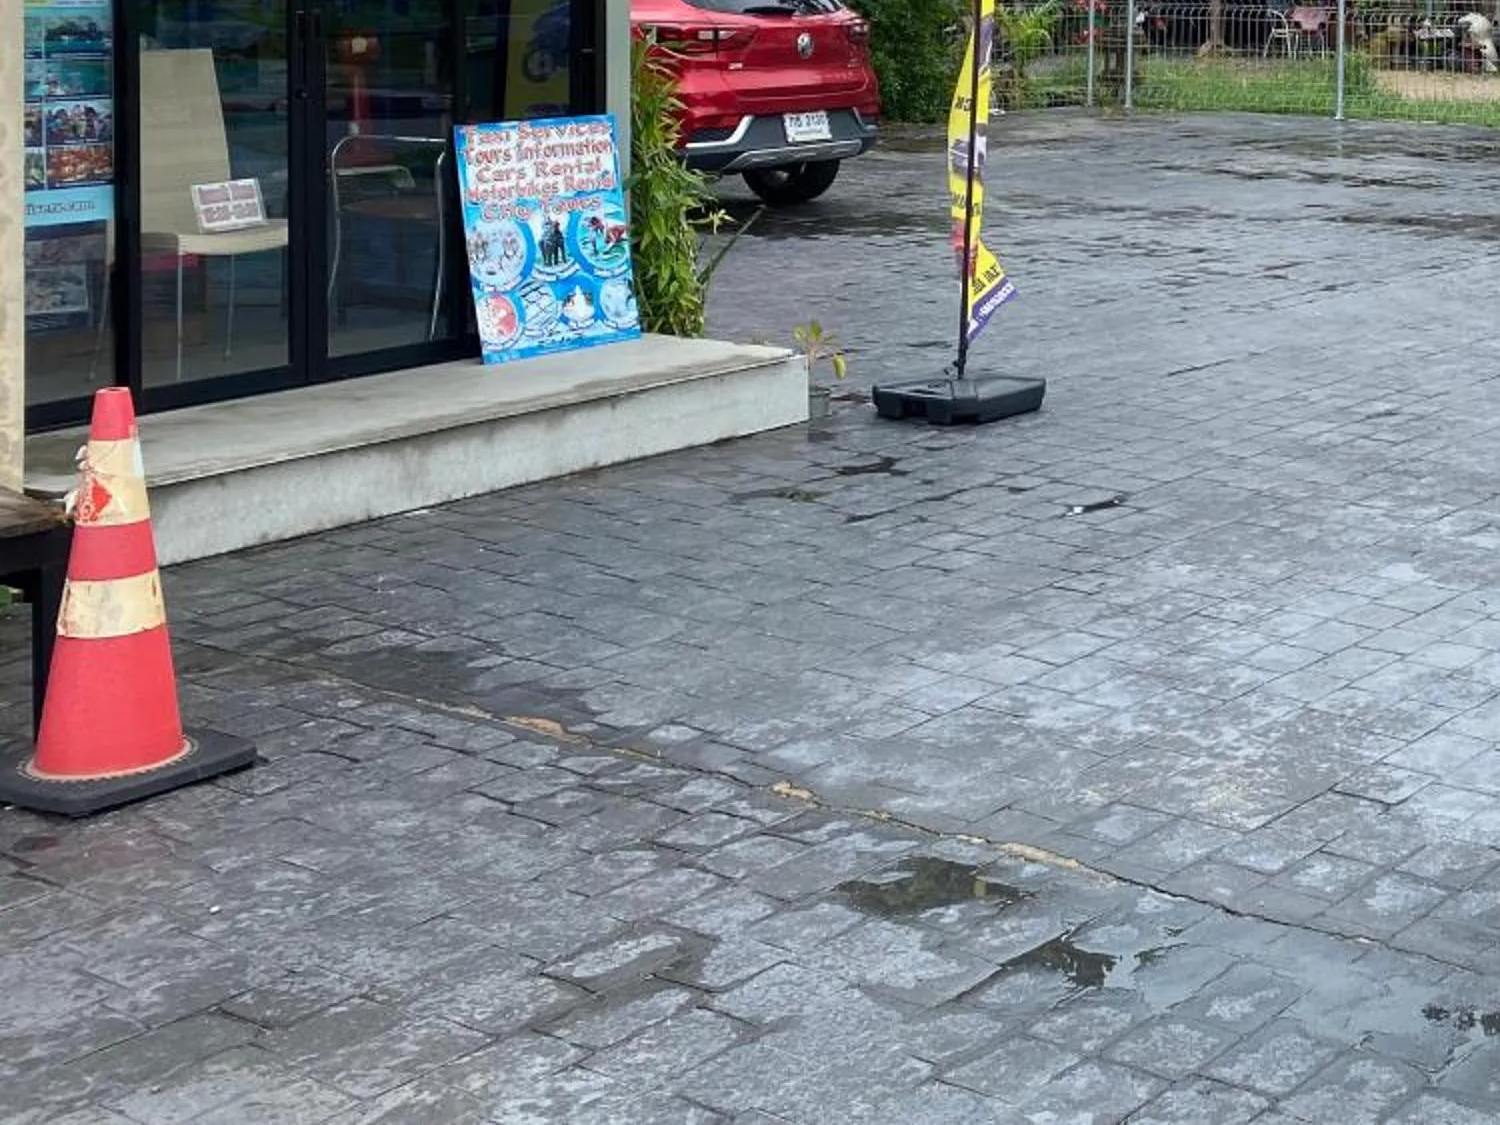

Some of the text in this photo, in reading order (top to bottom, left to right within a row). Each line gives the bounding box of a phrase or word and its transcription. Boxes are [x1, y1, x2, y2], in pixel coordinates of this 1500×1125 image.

[518, 122, 612, 140] Services
[465, 137, 612, 165] Tours Information
[475, 156, 602, 183] Cars Rental
